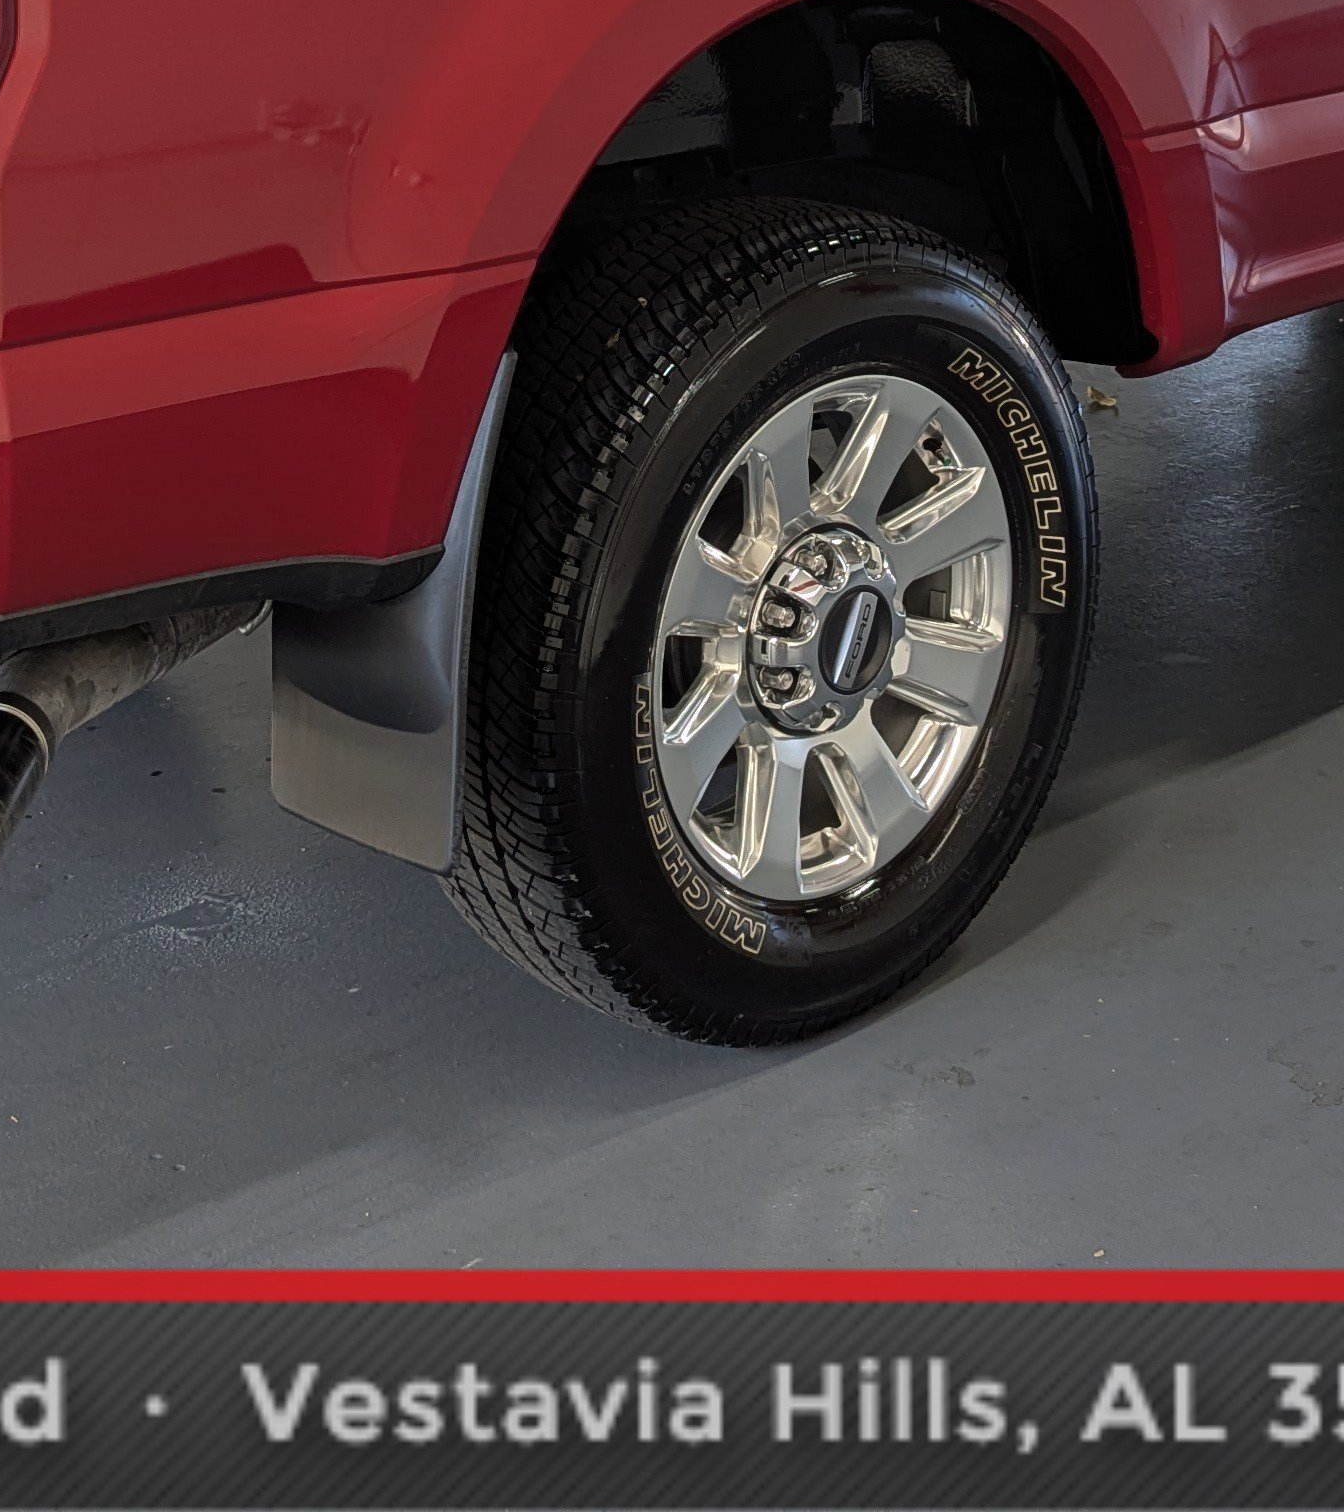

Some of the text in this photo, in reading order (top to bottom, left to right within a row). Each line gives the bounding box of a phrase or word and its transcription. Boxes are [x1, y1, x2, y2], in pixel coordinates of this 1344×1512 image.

[946, 346, 1067, 608] MICHELIN
[844, 602, 872, 679] FORD
[634, 683, 767, 955] MICHELIN
